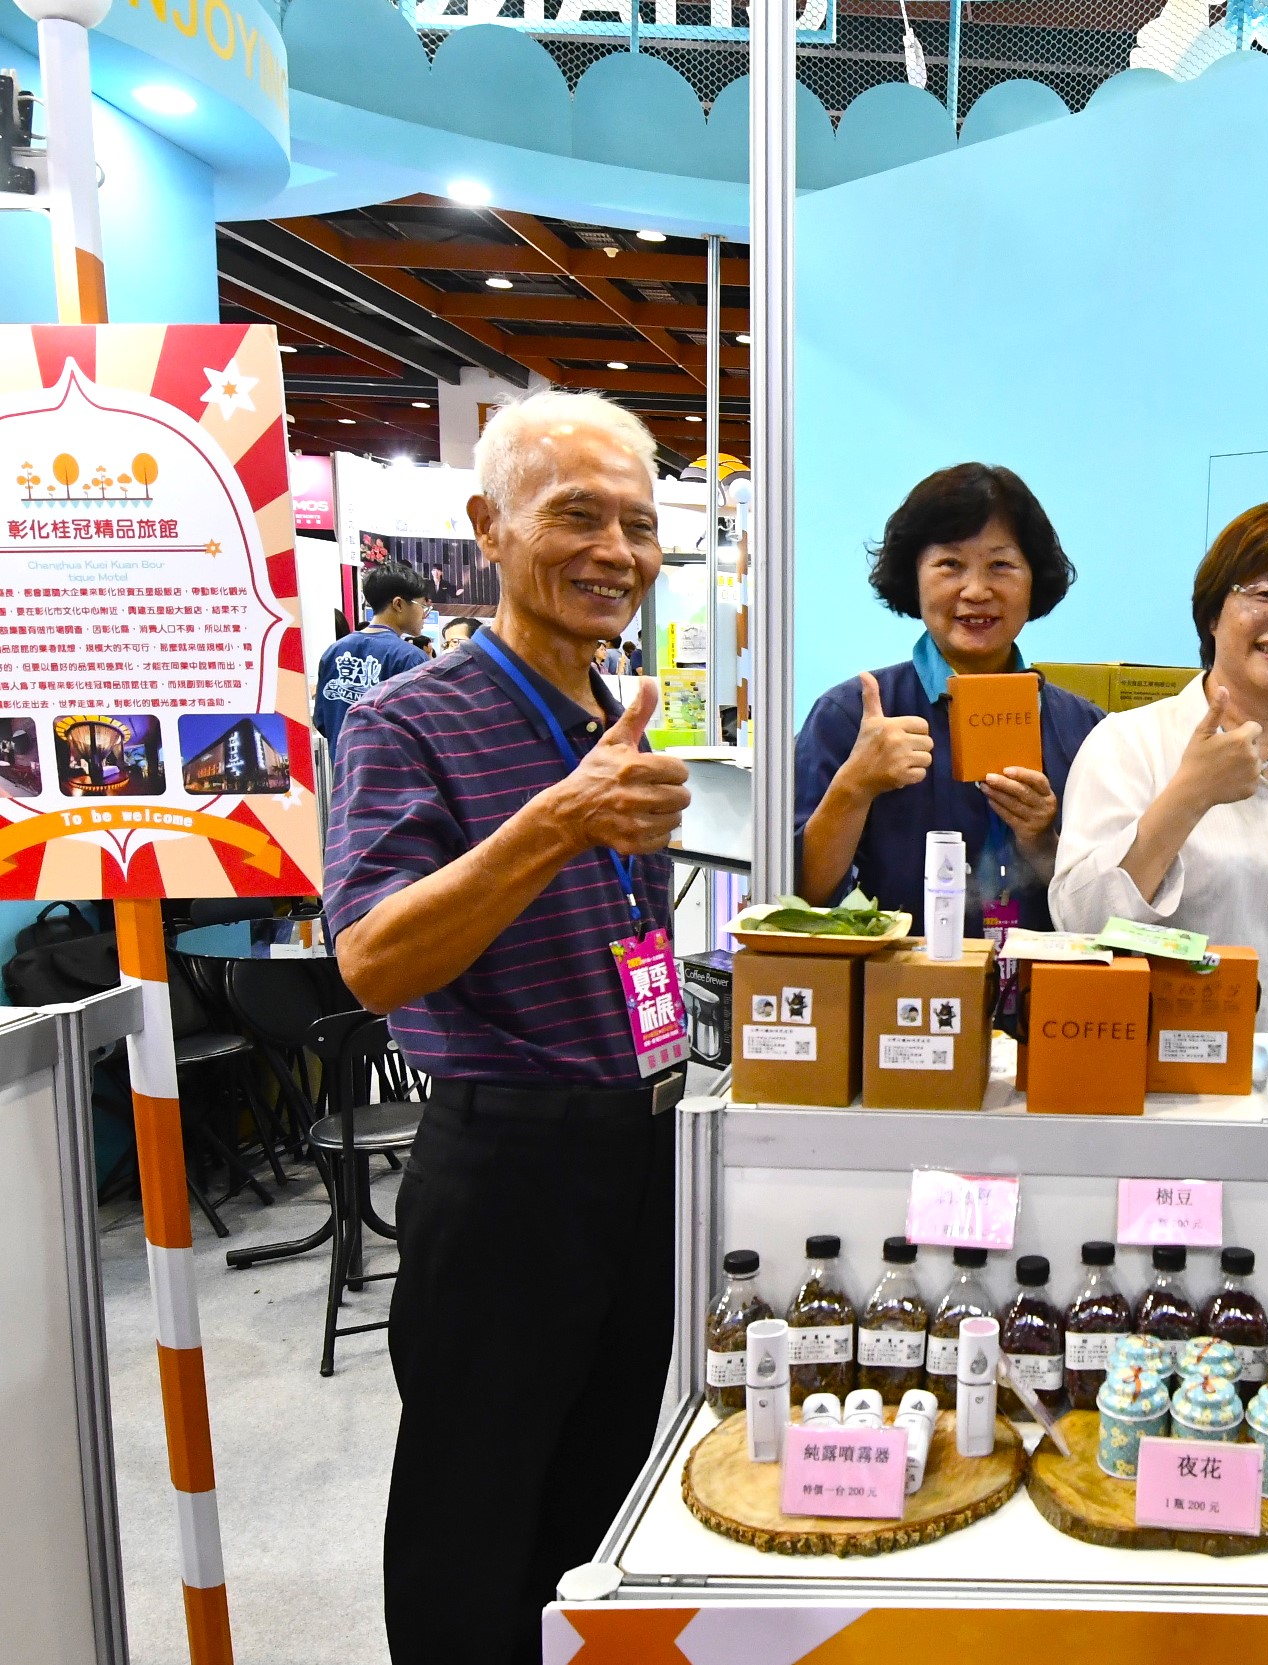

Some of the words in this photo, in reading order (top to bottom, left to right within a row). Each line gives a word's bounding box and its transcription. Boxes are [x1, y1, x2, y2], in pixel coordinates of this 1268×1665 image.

[7, 518, 179, 540] 彰化桂冠精品旅館
[28, 560, 82, 571] Changhua
[111, 560, 139, 570] Kuan
[98, 572, 128, 582] Motel
[968, 711, 1033, 728] COFFEE
[60, 812, 83, 827] To
[92, 808, 112, 823] be
[122, 809, 194, 828] welcome
[629, 961, 671, 1001] 夏季
[684, 967, 705, 983] Coffee
[705, 971, 730, 987] Brewer
[637, 992, 677, 1034] 旅展
[1042, 1020, 1137, 1041] COFFEE
[1156, 1187, 1193, 1206] 樹豆
[803, 1443, 890, 1464] 純露噴霧器
[1177, 1454, 1222, 1479] 夜花
[803, 1484, 845, 1496] 特價一台
[848, 1486, 864, 1496] 200
[867, 1487, 878, 1498] 元
[1174, 1498, 1185, 1510] 瓶
[1188, 1500, 1206, 1511] 200
[1209, 1502, 1220, 1513] 元
